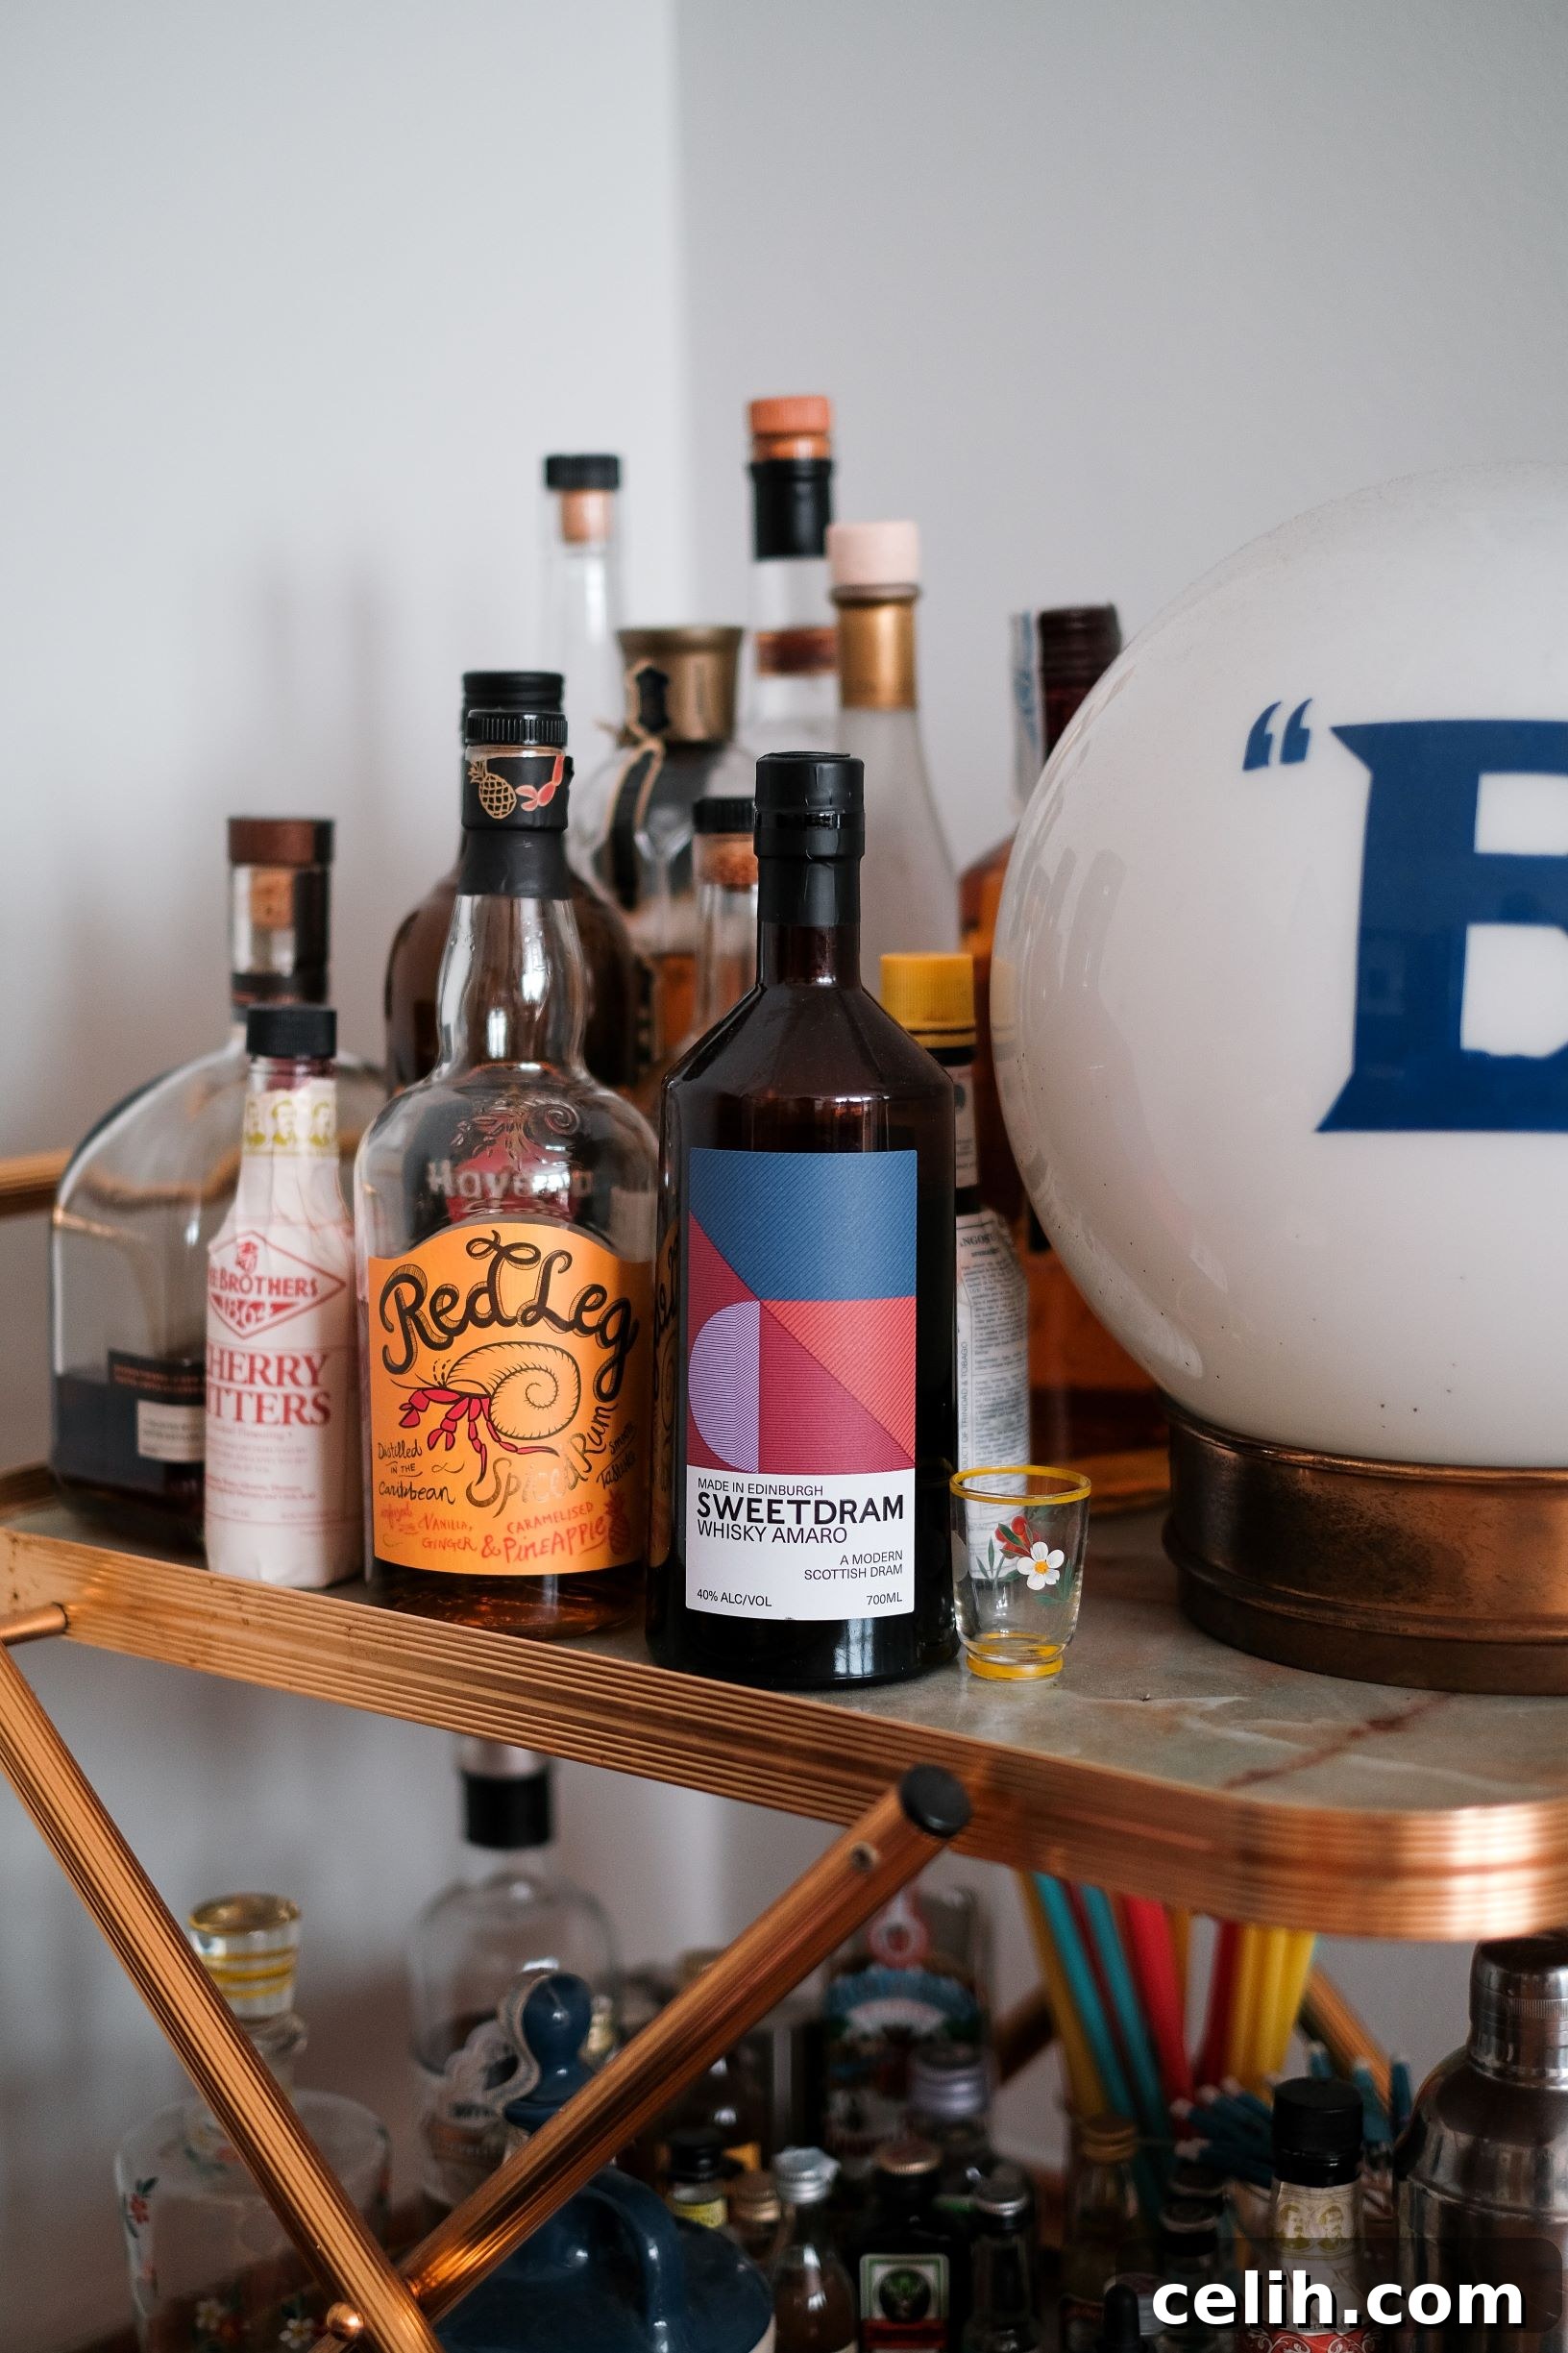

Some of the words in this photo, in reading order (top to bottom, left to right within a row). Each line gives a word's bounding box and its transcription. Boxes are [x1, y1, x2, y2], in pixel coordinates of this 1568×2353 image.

[220, 1266, 319, 1298] BROTHERS
[208, 1344, 329, 1386] HERRY
[207, 1383, 331, 1426] ITTERS
[378, 1439, 423, 1459] Distilled
[569, 1402, 618, 1474] Rum
[390, 1465, 398, 1474] IN
[401, 1463, 416, 1472] THE
[379, 1481, 456, 1506] Caribbean
[698, 1477, 729, 1492] MADE
[732, 1482, 745, 1494] IN
[748, 1483, 823, 1496] EDINBURGH
[506, 1502, 595, 1534] CARAMELISED
[697, 1492, 904, 1525] SWEETDRAM
[698, 1519, 768, 1543] WHISKY
[772, 1527, 847, 1544] AMARO
[481, 1534, 501, 1558] &
[840, 1554, 849, 1565] A
[852, 1550, 903, 1565] MODERN
[804, 1567, 867, 1581] SCOTTISH
[870, 1564, 903, 1578] DRAM
[697, 1588, 719, 1602] 40%
[721, 1592, 772, 1607] ALC/VOL
[867, 1592, 903, 1605] 700ML
